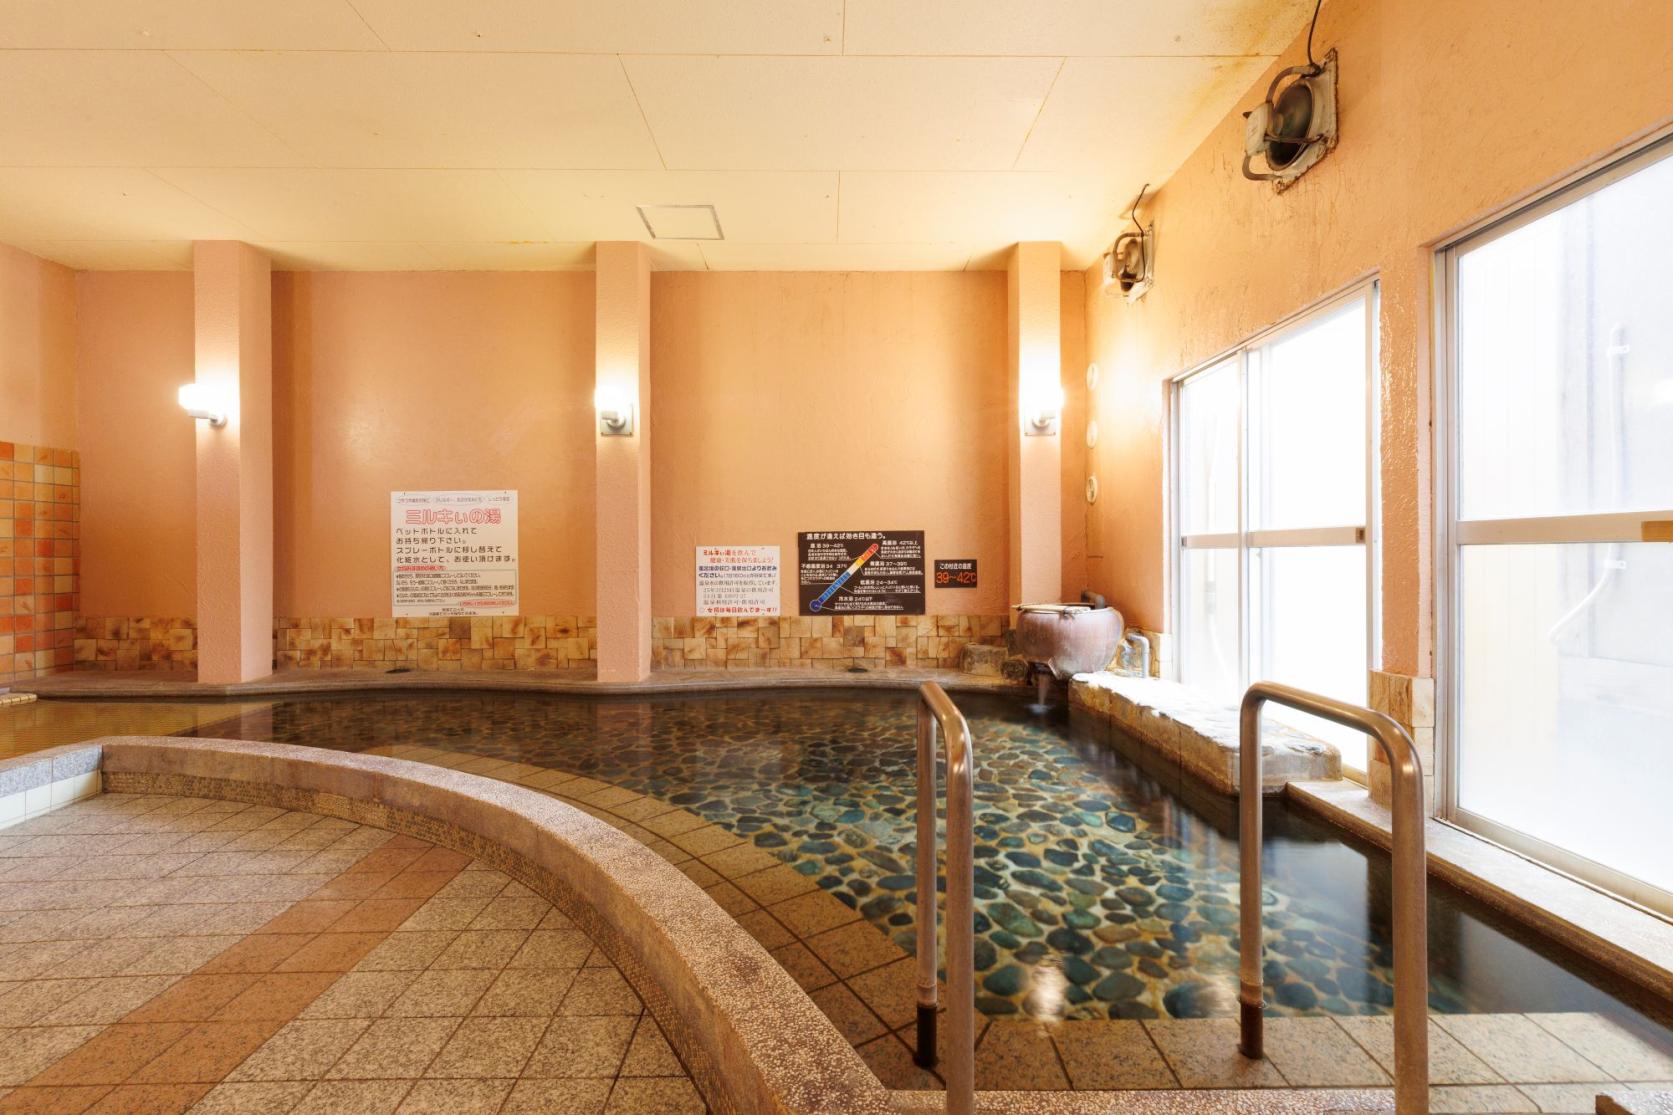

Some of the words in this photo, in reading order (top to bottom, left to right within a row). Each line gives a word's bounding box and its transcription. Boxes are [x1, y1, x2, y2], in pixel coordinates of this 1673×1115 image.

[396, 527, 478, 535] ペットボトルに入れて
[396, 537, 467, 545] お持ち帰り下さい。
[396, 546, 502, 554] スプレーボトルに移し替えて
